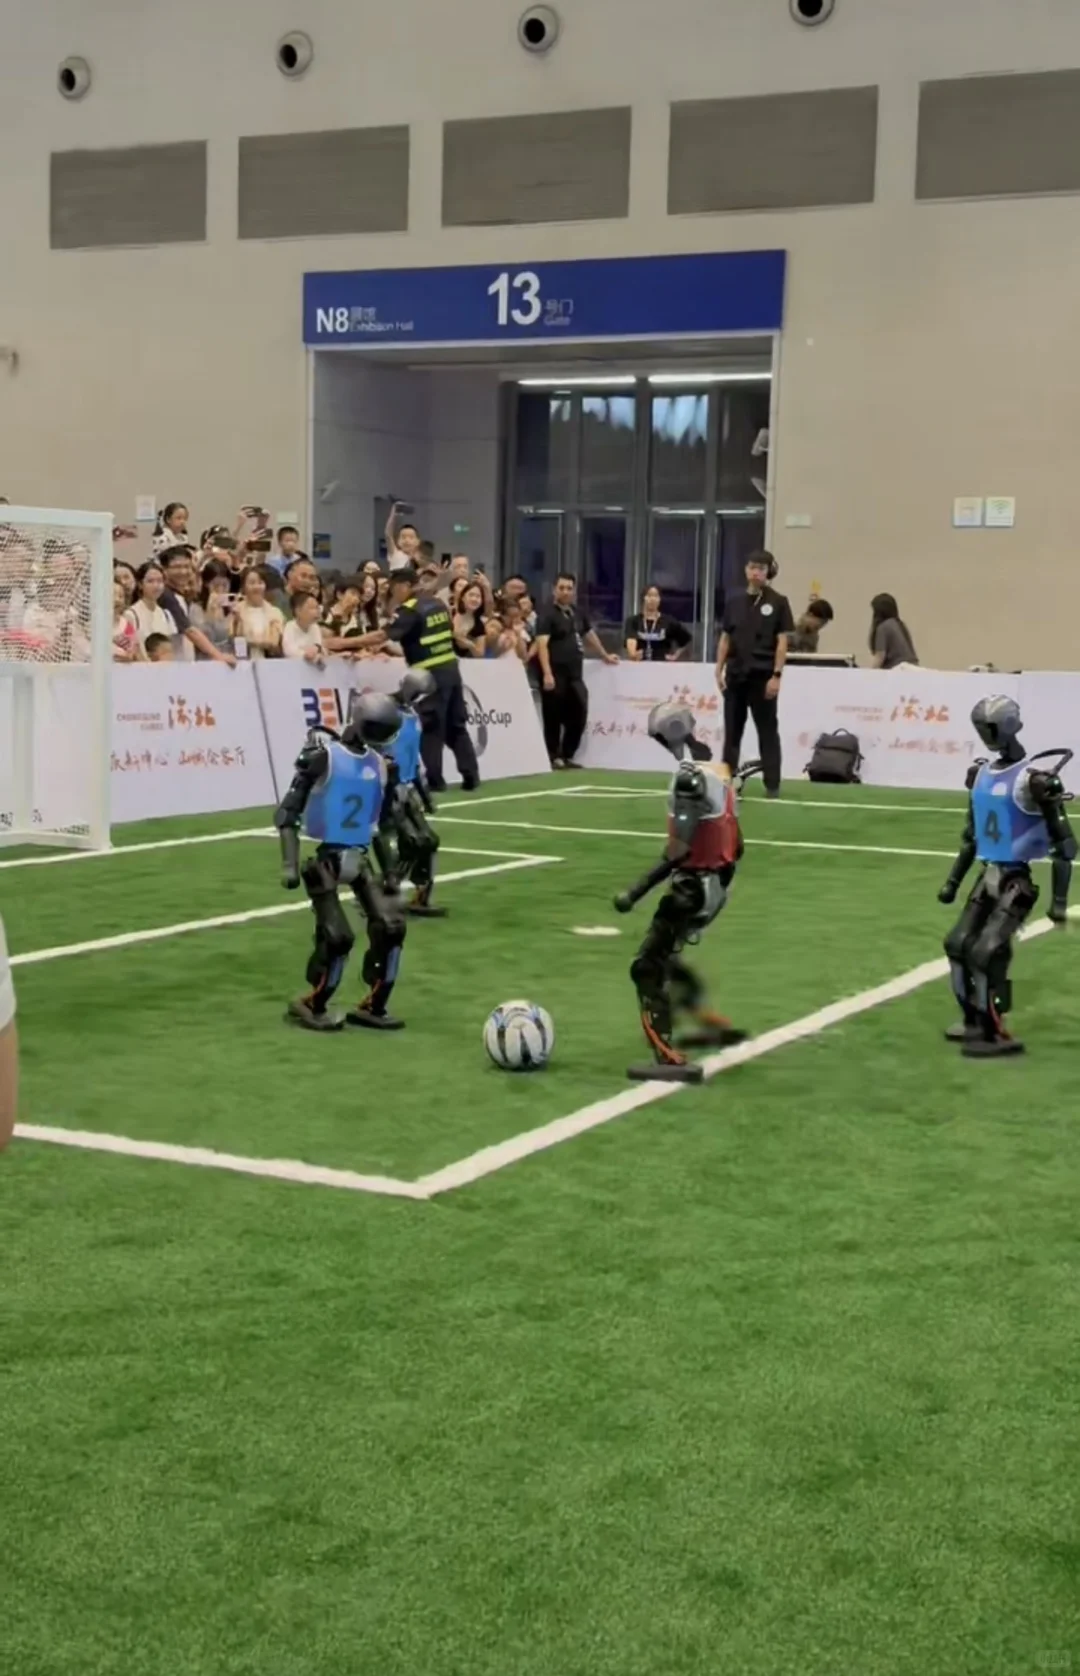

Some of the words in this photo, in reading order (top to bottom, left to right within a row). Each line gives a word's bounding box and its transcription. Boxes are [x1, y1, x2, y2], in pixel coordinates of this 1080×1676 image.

[488, 271, 542, 326] 13
[316, 307, 349, 333] N8
[466, 708, 512, 728] oboCup
[341, 794, 363, 829] 2
[984, 810, 1002, 844] 4
